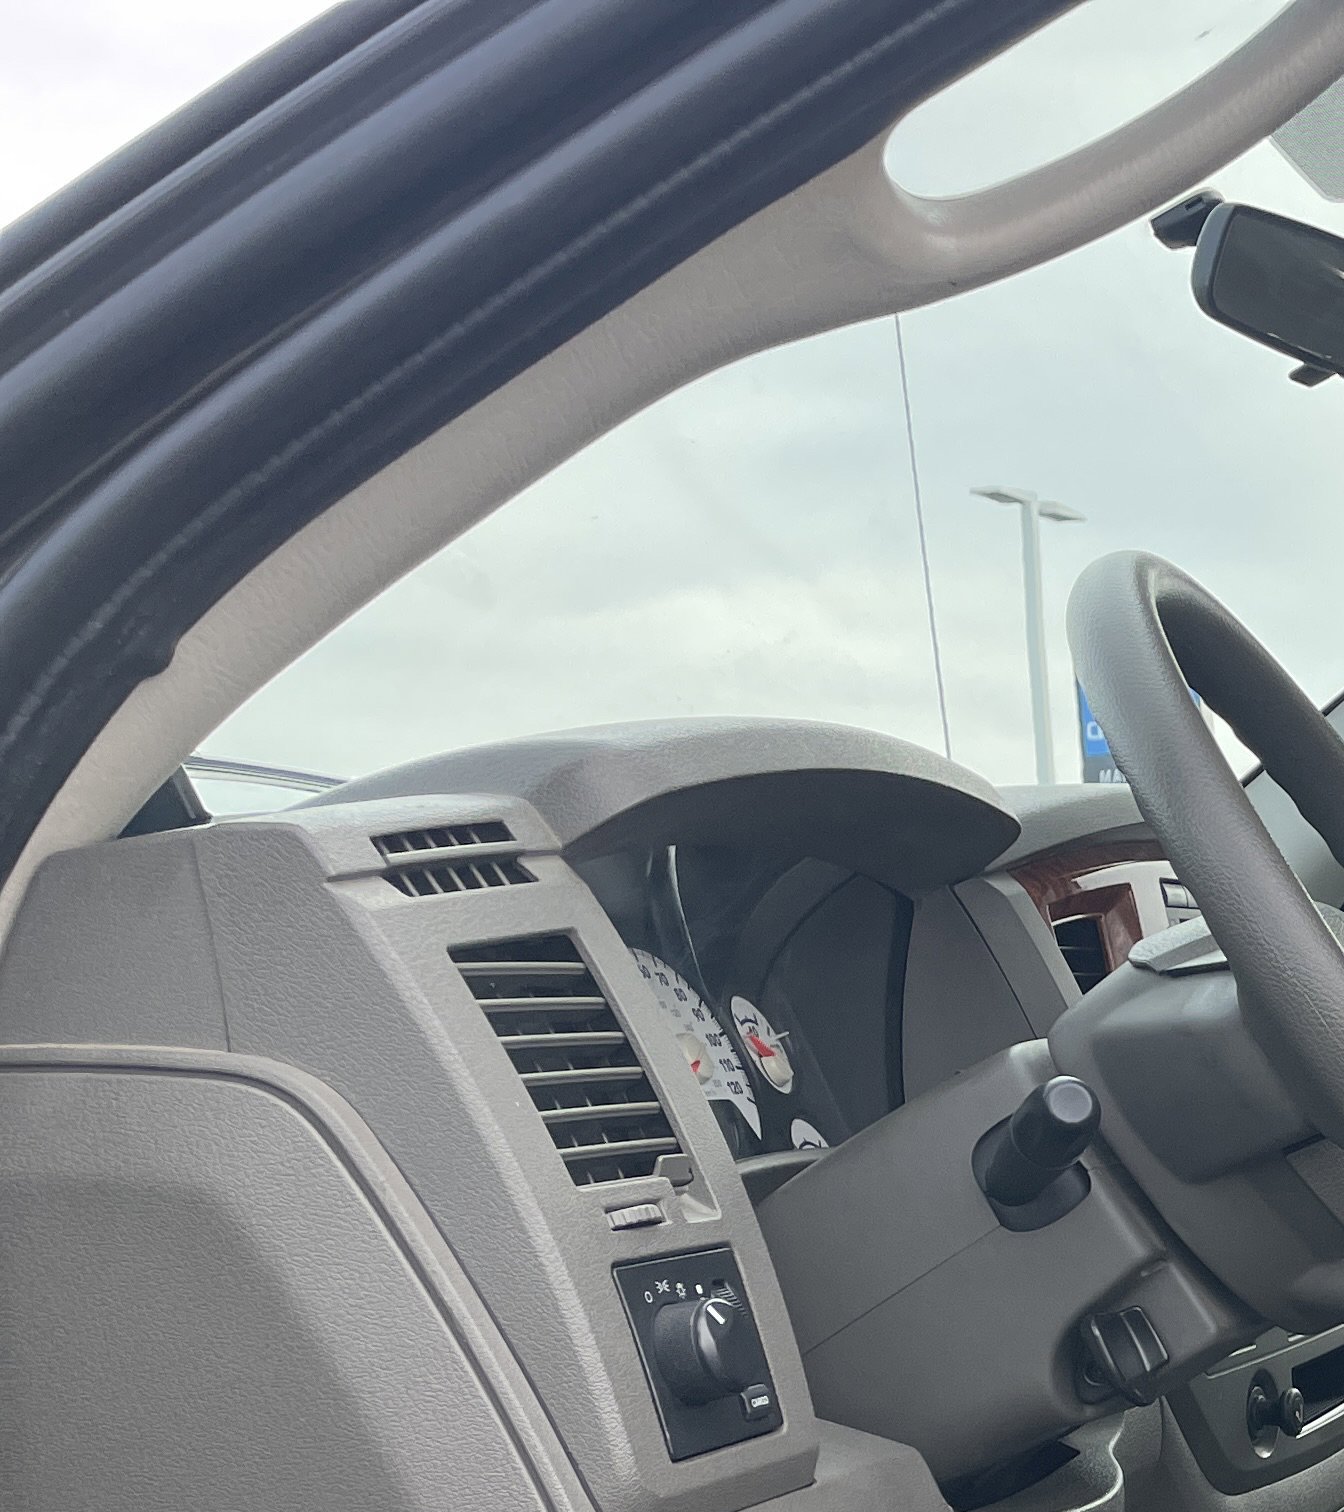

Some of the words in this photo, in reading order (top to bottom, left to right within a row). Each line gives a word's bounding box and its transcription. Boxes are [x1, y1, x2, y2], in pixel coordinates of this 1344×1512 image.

[654, 972, 670, 987] 70
[673, 987, 688, 1002] 80
[692, 1007, 706, 1022] 90
[705, 1033, 723, 1047] 100
[719, 1058, 736, 1073] 110
[726, 1081, 744, 1095] 120
